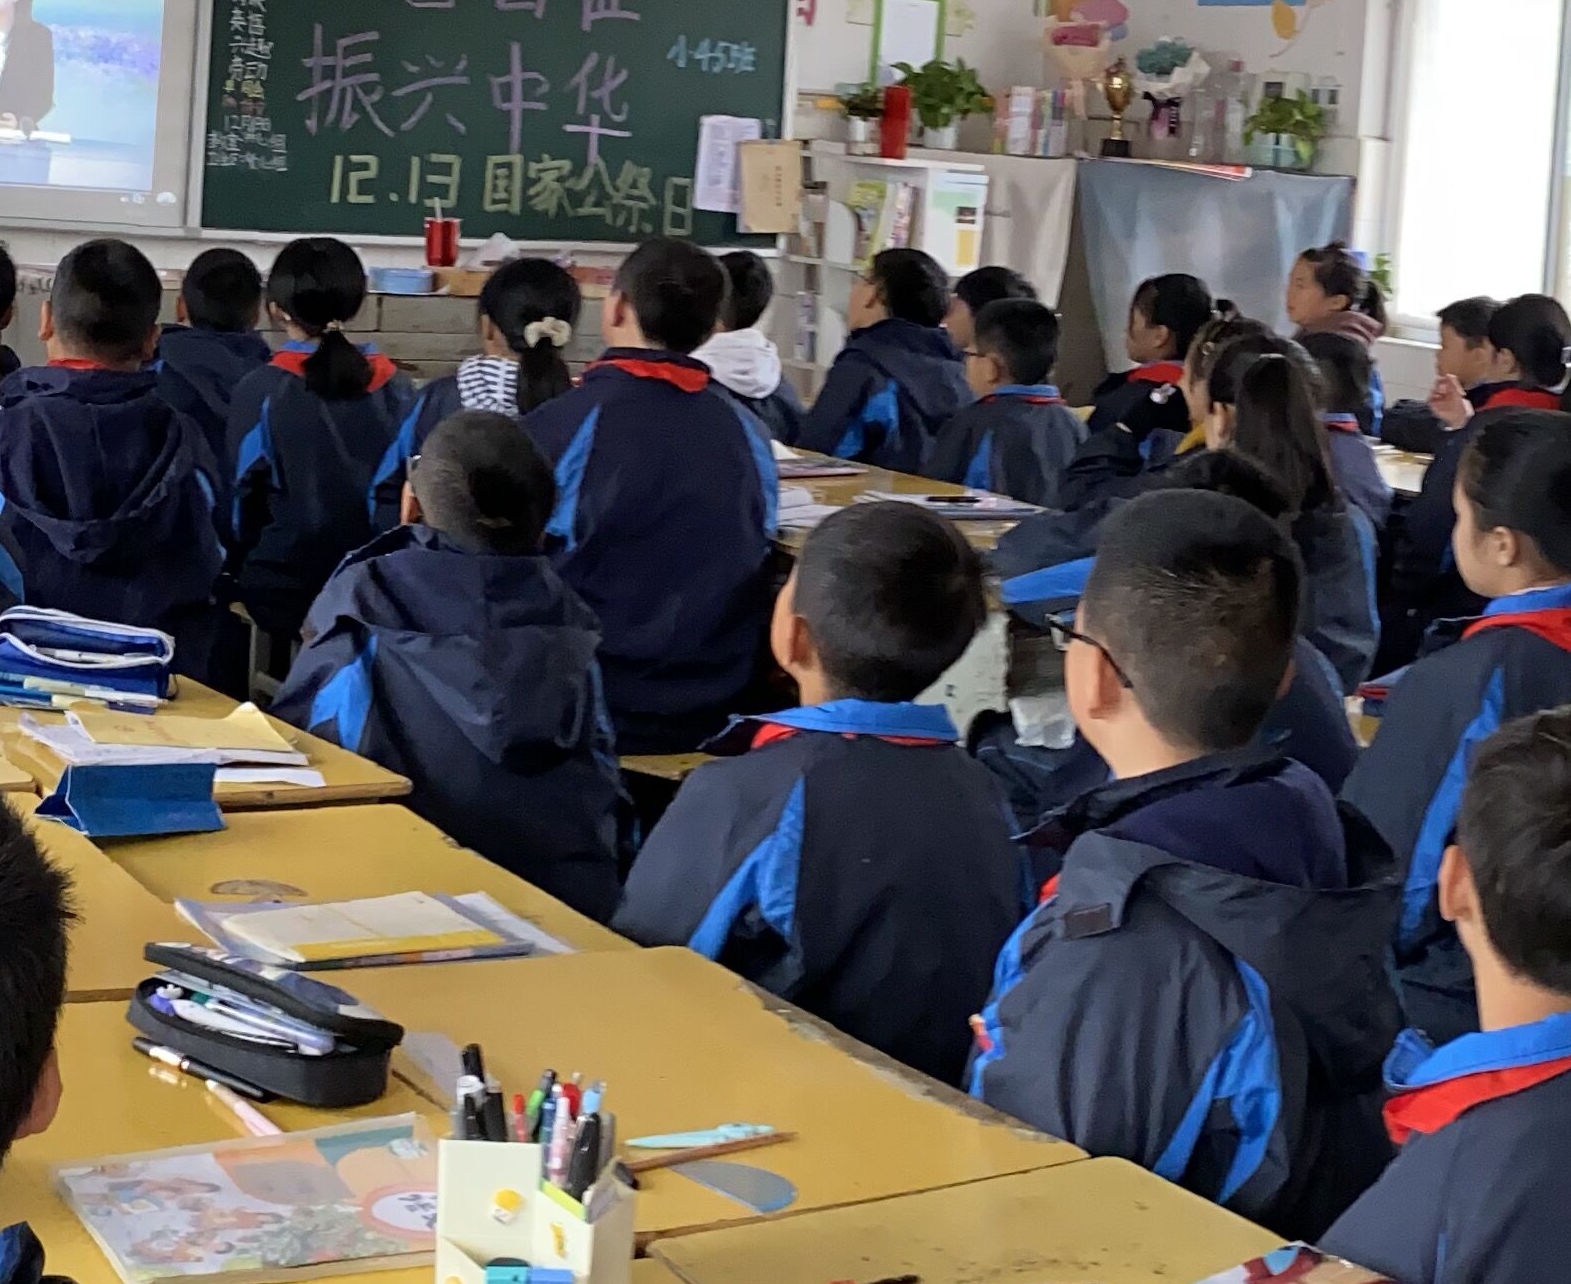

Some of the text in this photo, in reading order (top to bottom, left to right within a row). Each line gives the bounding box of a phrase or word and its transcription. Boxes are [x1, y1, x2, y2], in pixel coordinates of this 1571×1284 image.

[296, 22, 632, 164] 振兴中华
[329, 153, 463, 209] 12.13
[483, 154, 693, 238] 国家公祭日
